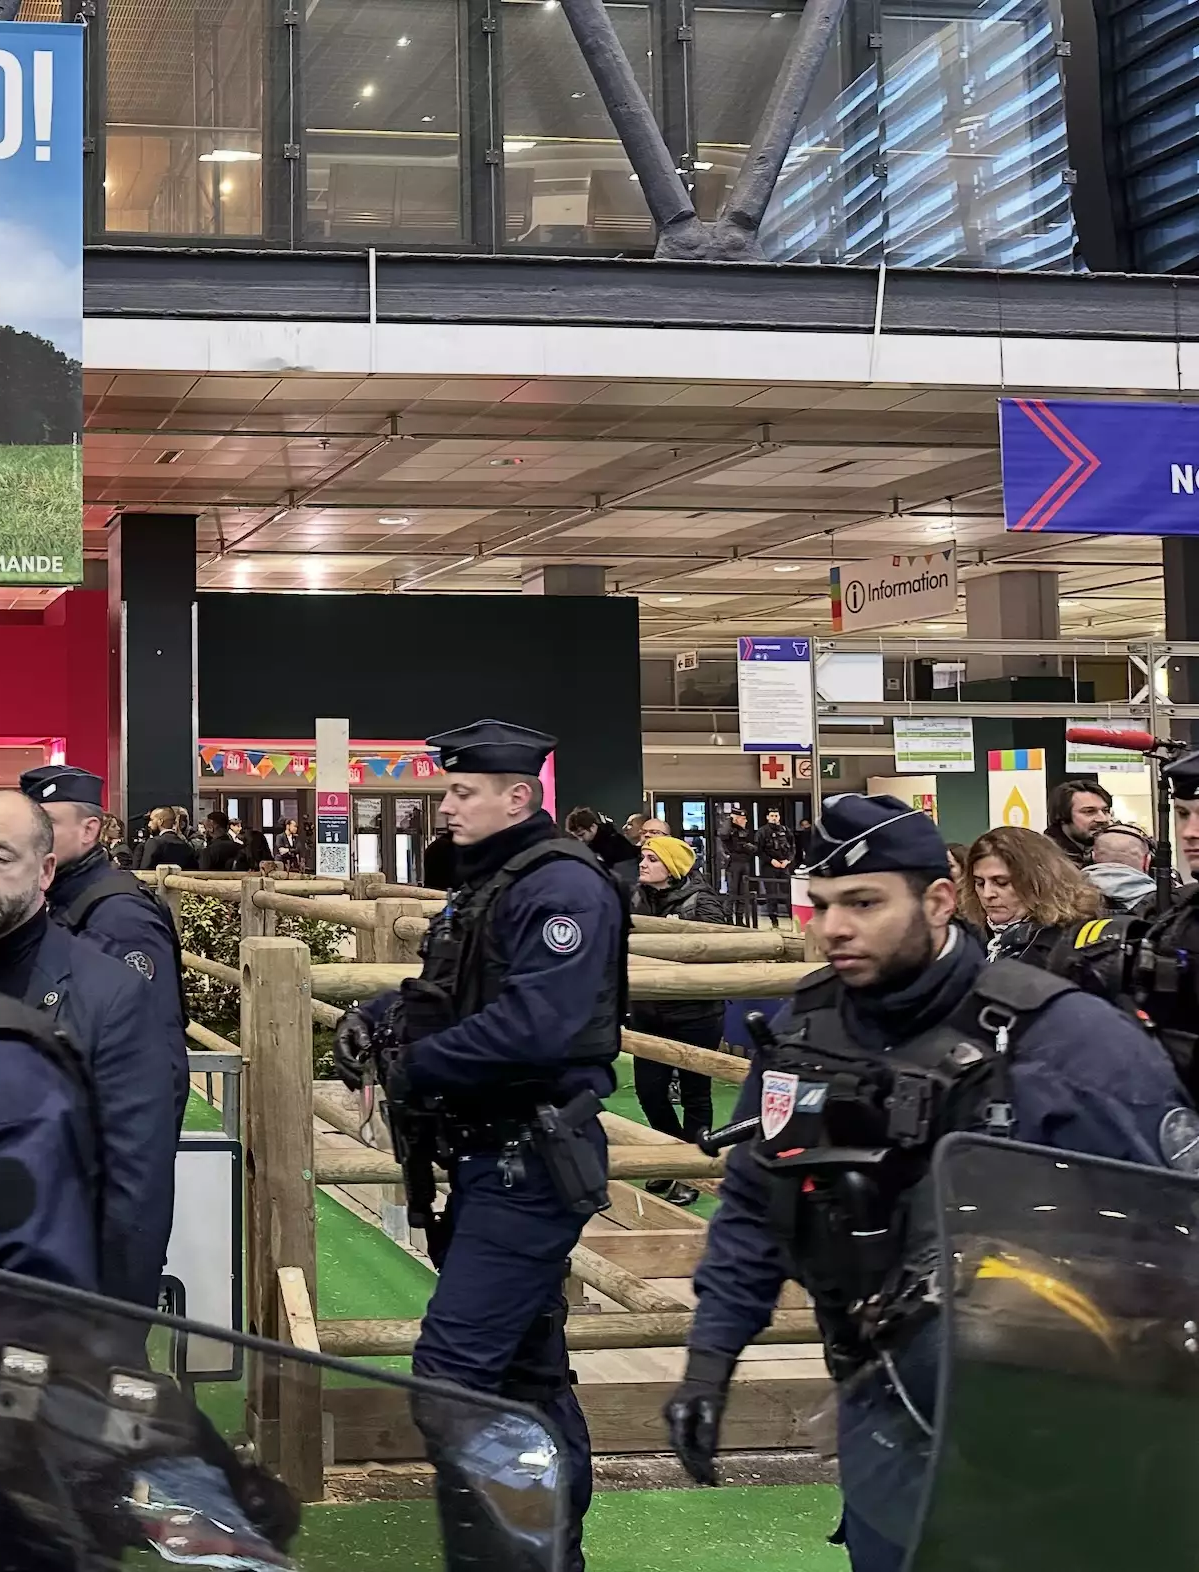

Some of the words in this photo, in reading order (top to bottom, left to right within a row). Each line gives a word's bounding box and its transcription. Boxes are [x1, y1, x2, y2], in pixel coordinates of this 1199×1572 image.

[1171, 463, 1199, 494] N
[868, 571, 948, 602] Information
[227, 754, 240, 765] 60
[417, 761, 430, 772] 60
